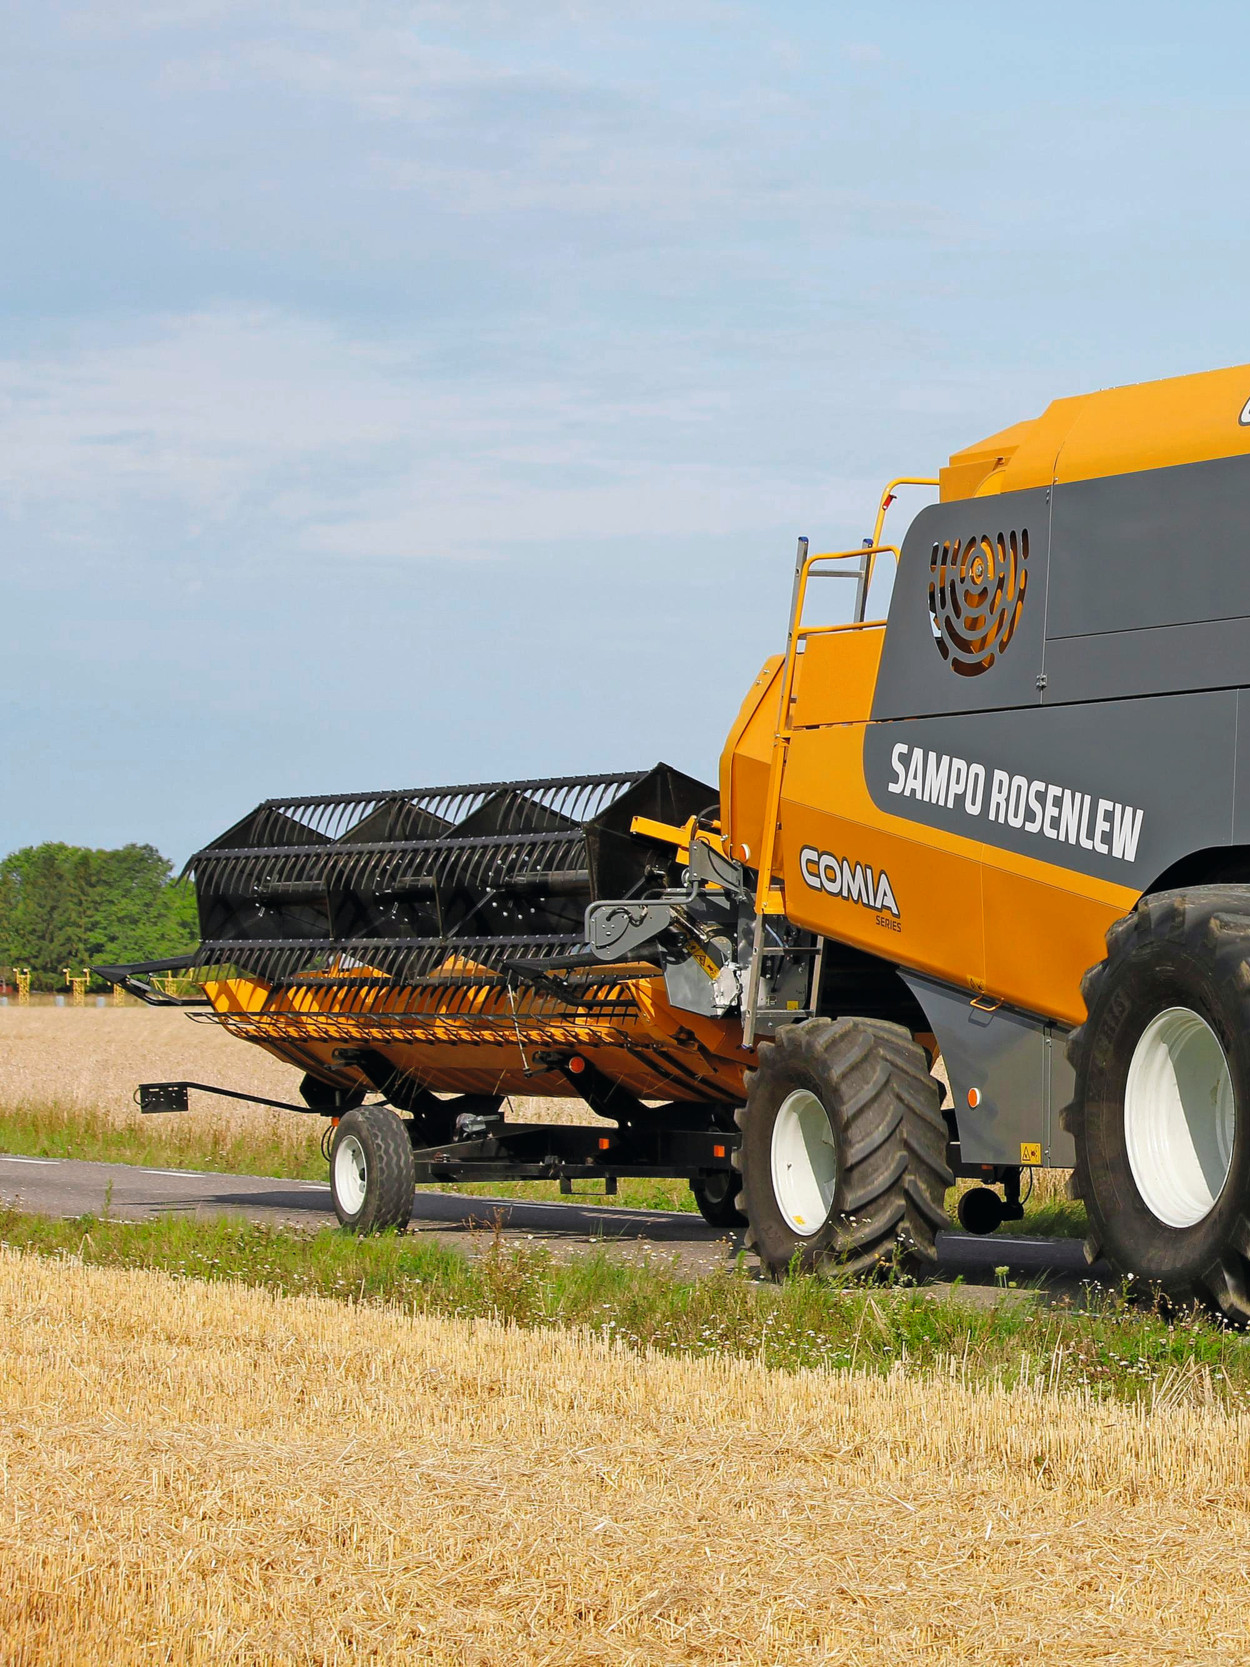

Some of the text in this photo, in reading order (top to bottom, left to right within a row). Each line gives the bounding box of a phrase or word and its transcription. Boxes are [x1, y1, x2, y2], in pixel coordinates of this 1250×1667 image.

[888, 743, 1144, 862] SAMPO ROSENLEW
[800, 845, 900, 918] COMIA
[875, 915, 902, 933] SERIES
